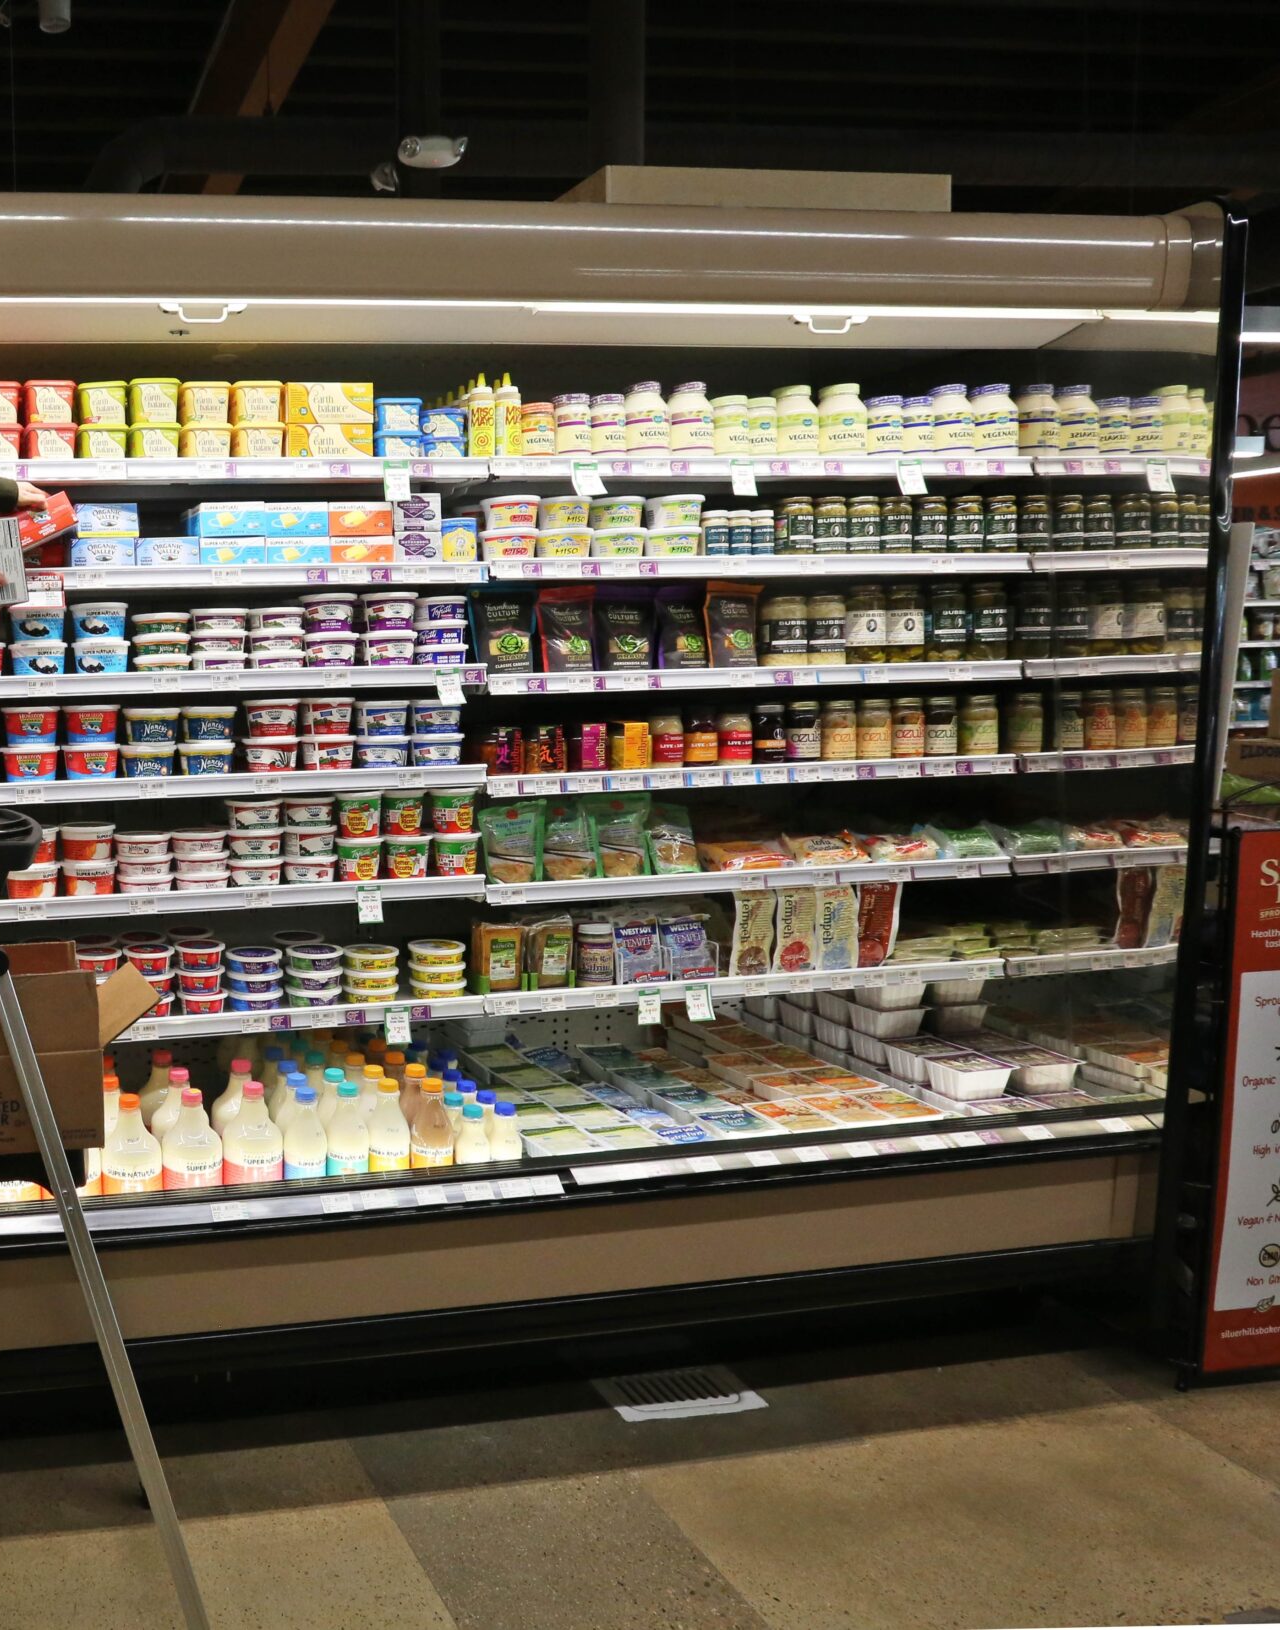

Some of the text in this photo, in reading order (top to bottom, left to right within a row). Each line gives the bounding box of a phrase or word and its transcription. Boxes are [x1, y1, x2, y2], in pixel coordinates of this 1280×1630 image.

[487, 610, 520, 618] CULTURE
[791, 731, 820, 744] ozuk
[595, 725, 606, 766] wildbrine
[637, 725, 647, 766] wildbrine
[741, 898, 750, 943] tempeh
[782, 895, 794, 939] tempeh
[819, 902, 834, 944] tempeh
[620, 926, 652, 936] WEST SOY
[670, 921, 702, 932] WEST SOY
[1242, 1075, 1276, 1090] Organic
[1253, 1145, 1271, 1158] High
[1237, 1215, 1265, 1230] Vegan
[1246, 1276, 1264, 1287] Non
